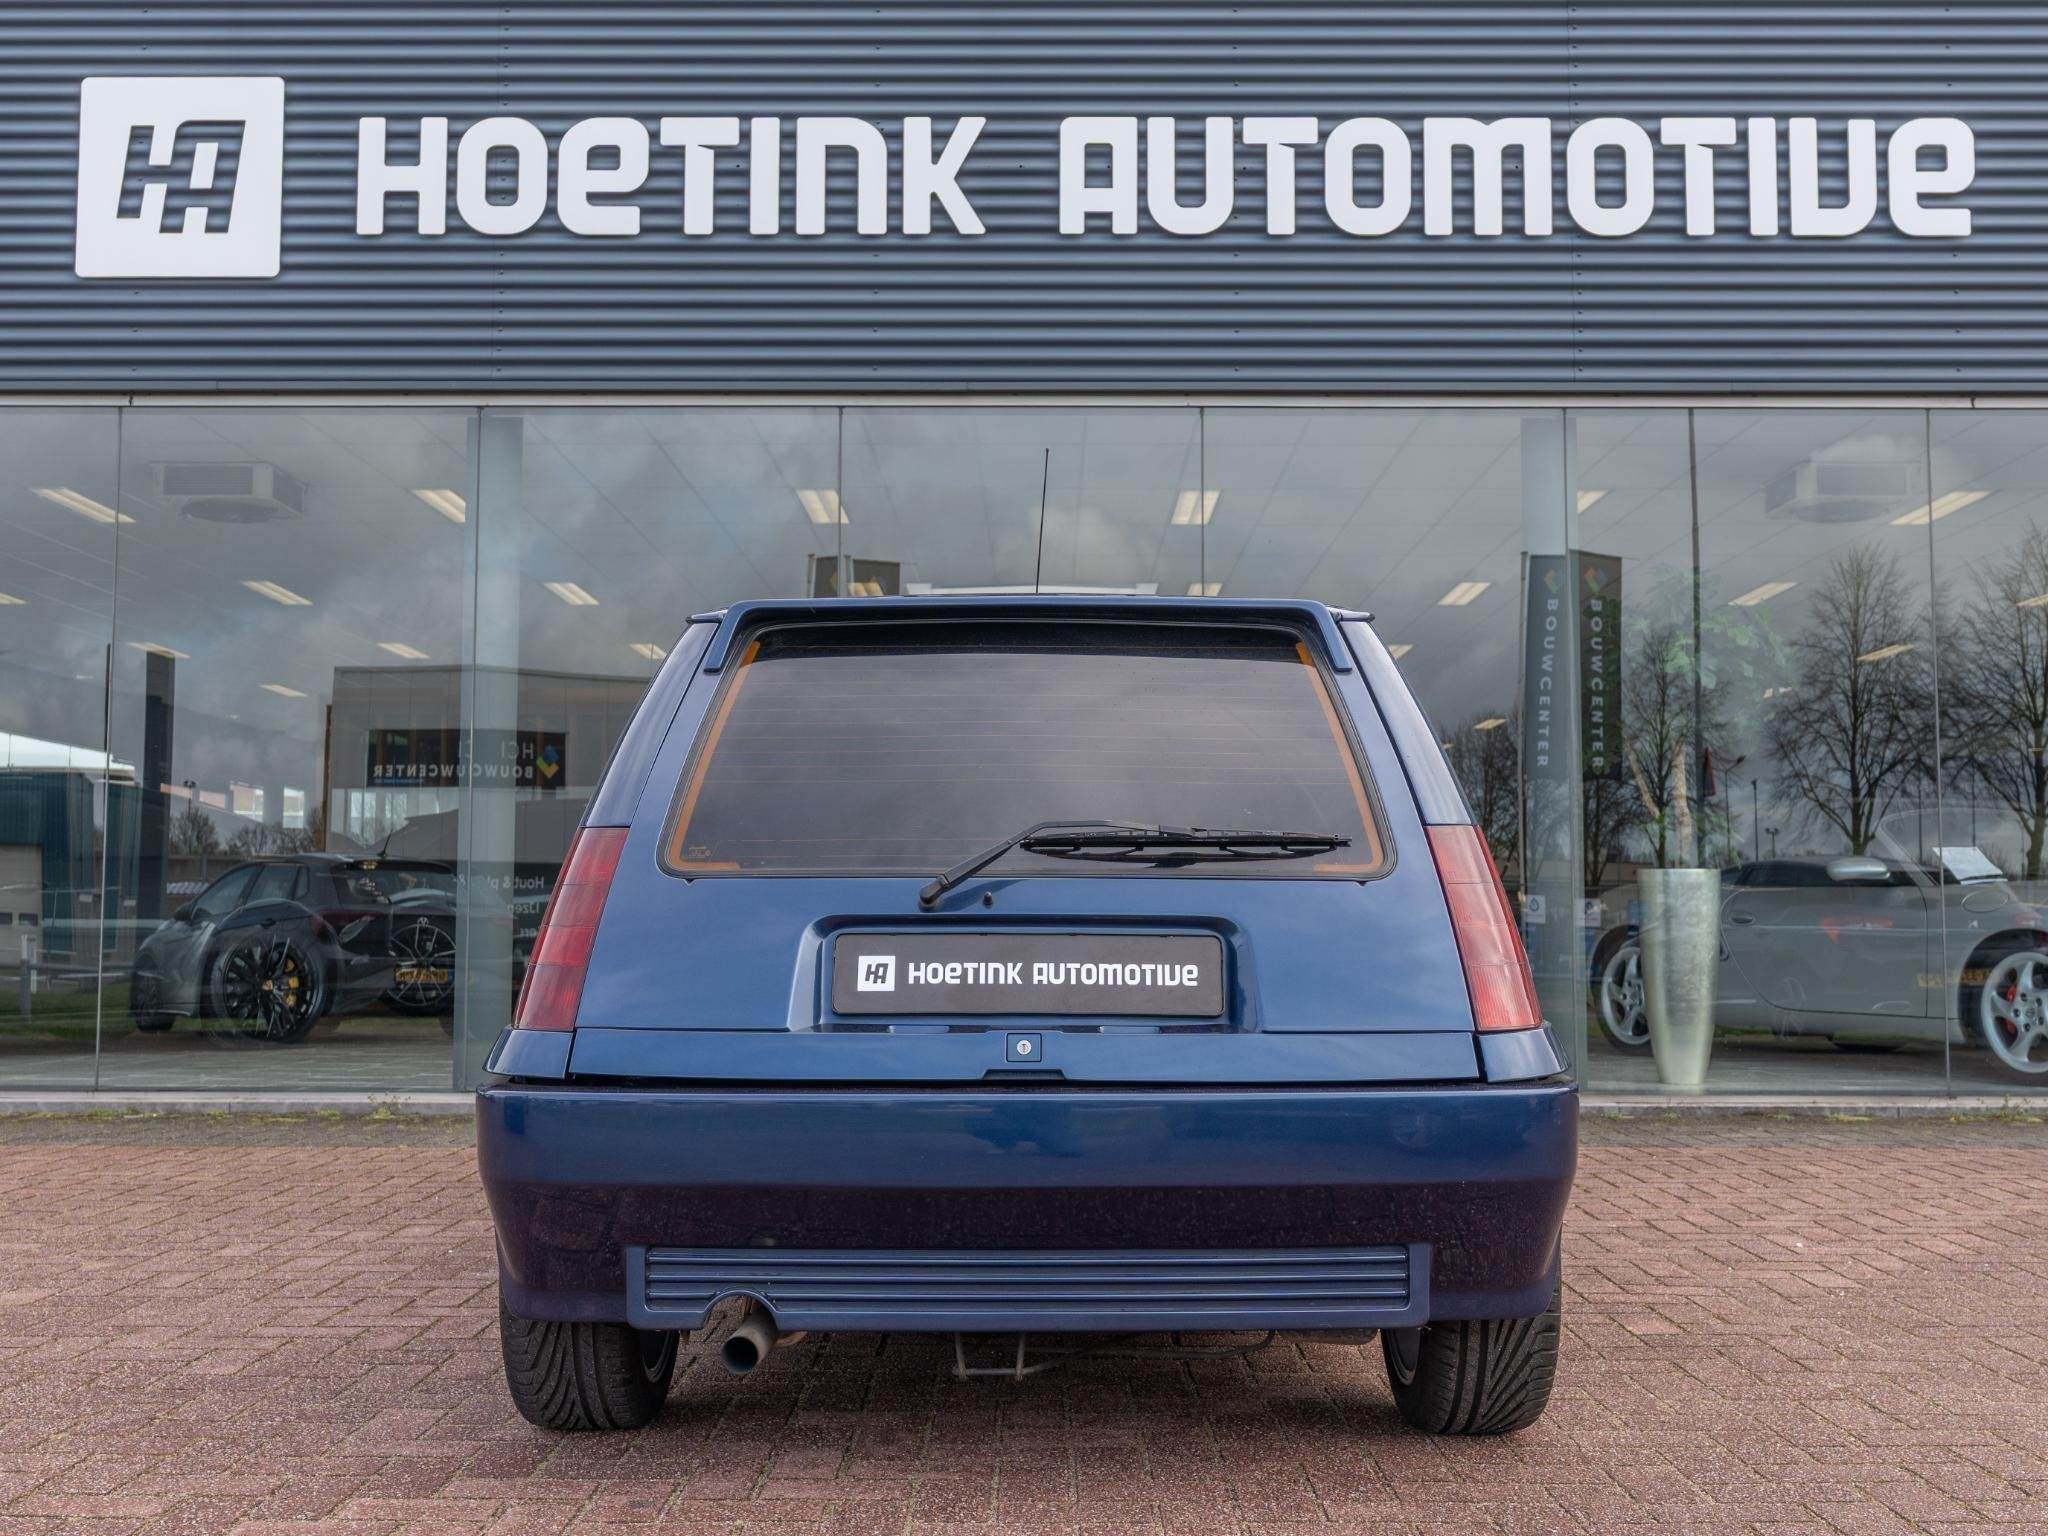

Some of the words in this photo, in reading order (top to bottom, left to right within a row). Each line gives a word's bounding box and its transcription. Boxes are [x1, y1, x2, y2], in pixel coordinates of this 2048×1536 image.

[356, 116, 987, 236] HOETINK
[1059, 116, 1976, 237] AUTOMOTIVE
[1536, 598, 1559, 767] BOUWCENTER
[1590, 598, 1604, 767] BOUWCENTER
[908, 962, 1023, 985] HOETINK
[1032, 962, 1200, 987] AUTOMOTIVE
